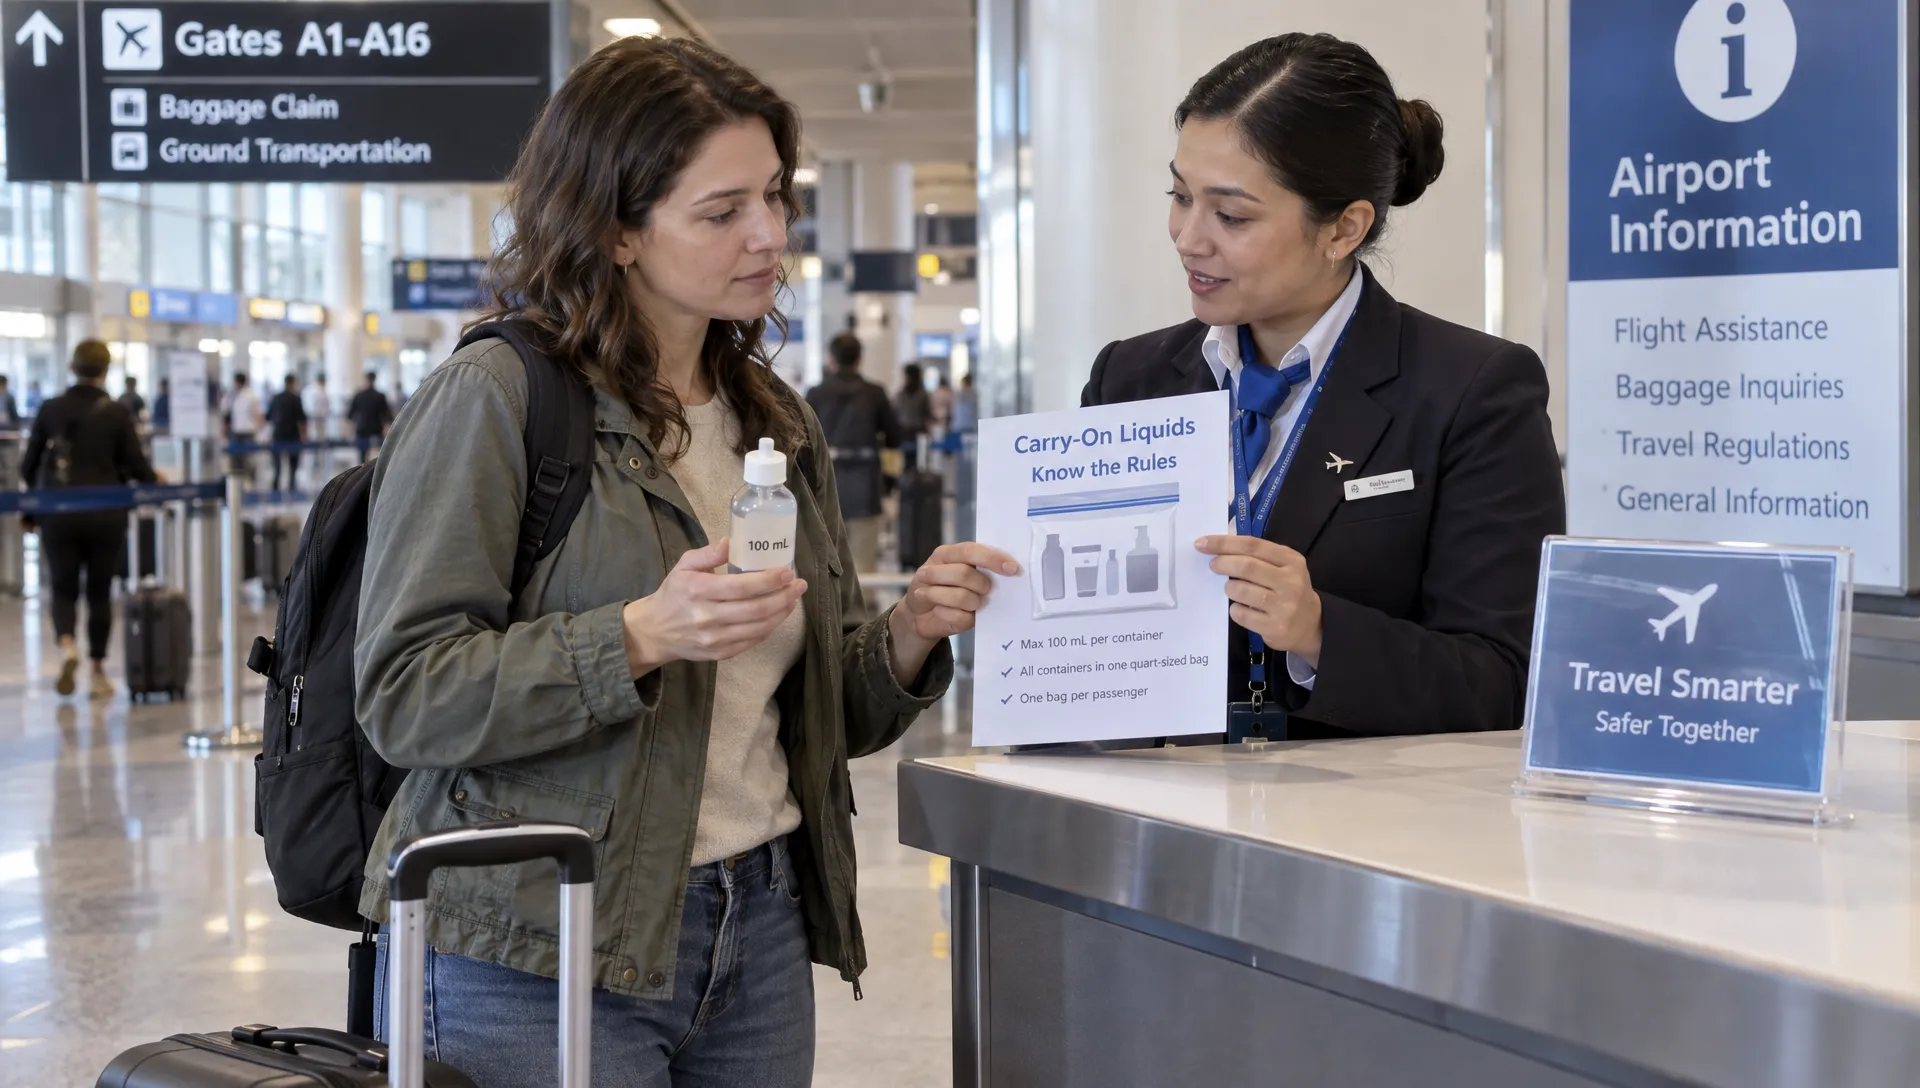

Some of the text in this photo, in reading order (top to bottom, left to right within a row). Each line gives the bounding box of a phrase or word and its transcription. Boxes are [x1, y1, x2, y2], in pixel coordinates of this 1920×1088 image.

[174, 20, 431, 57] Gates A1-A16
[159, 93, 338, 124] Baggage Claim
[159, 138, 431, 167] Ground Transportation
[1609, 149, 1771, 204] Airport
[1610, 200, 1862, 254] Information
[1614, 315, 1829, 349] Flight Assistance
[1616, 372, 1844, 405] Baggage Inquiries
[1014, 417, 1196, 454] Carry-On Liquids
[1616, 430, 1850, 464] Travel Regulations
[1032, 453, 1178, 483] Know the Rules
[1617, 485, 1870, 520] General Information
[748, 538, 789, 551] 100 mL
[1020, 630, 1164, 650] Max 100 mL per container
[1020, 653, 1210, 677] All containers in one quart-sized bag
[1020, 687, 1148, 704] One bag per passenger
[1569, 662, 1800, 706] Travel Smarter
[1595, 711, 1760, 745] Safer Together
